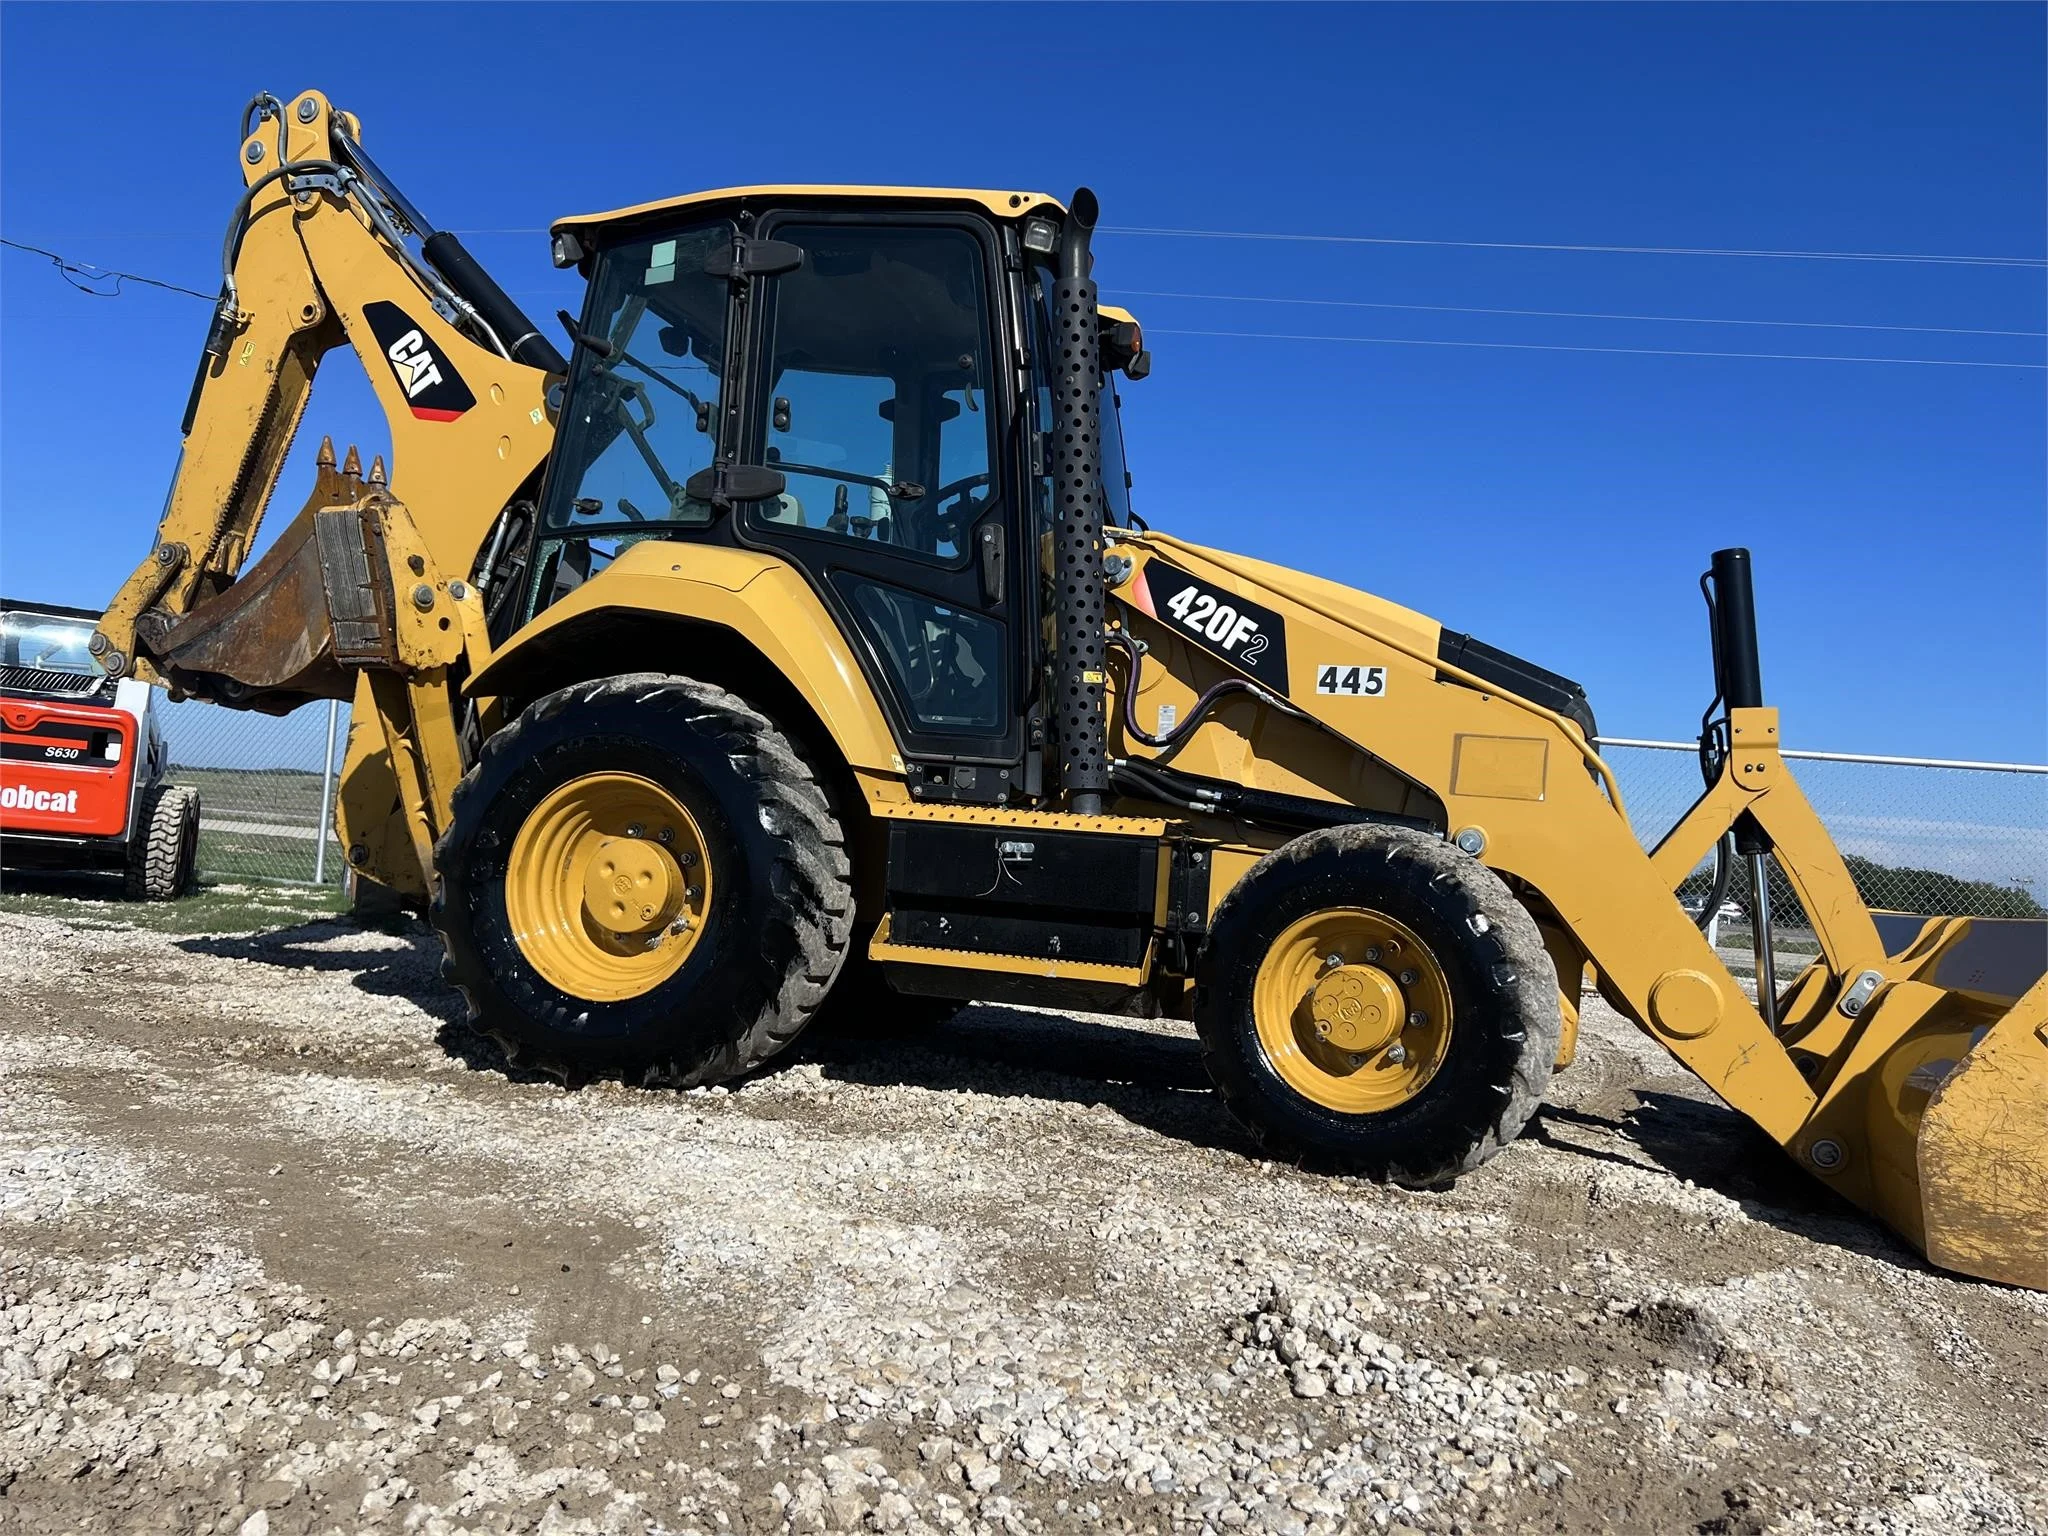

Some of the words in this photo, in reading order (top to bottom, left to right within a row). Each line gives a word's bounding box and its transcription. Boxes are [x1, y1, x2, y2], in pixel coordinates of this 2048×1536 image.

[388, 329, 442, 398] CAT
[1319, 667, 1382, 694] 445
[44, 746, 80, 759] S630
[0, 784, 78, 814] obcat
